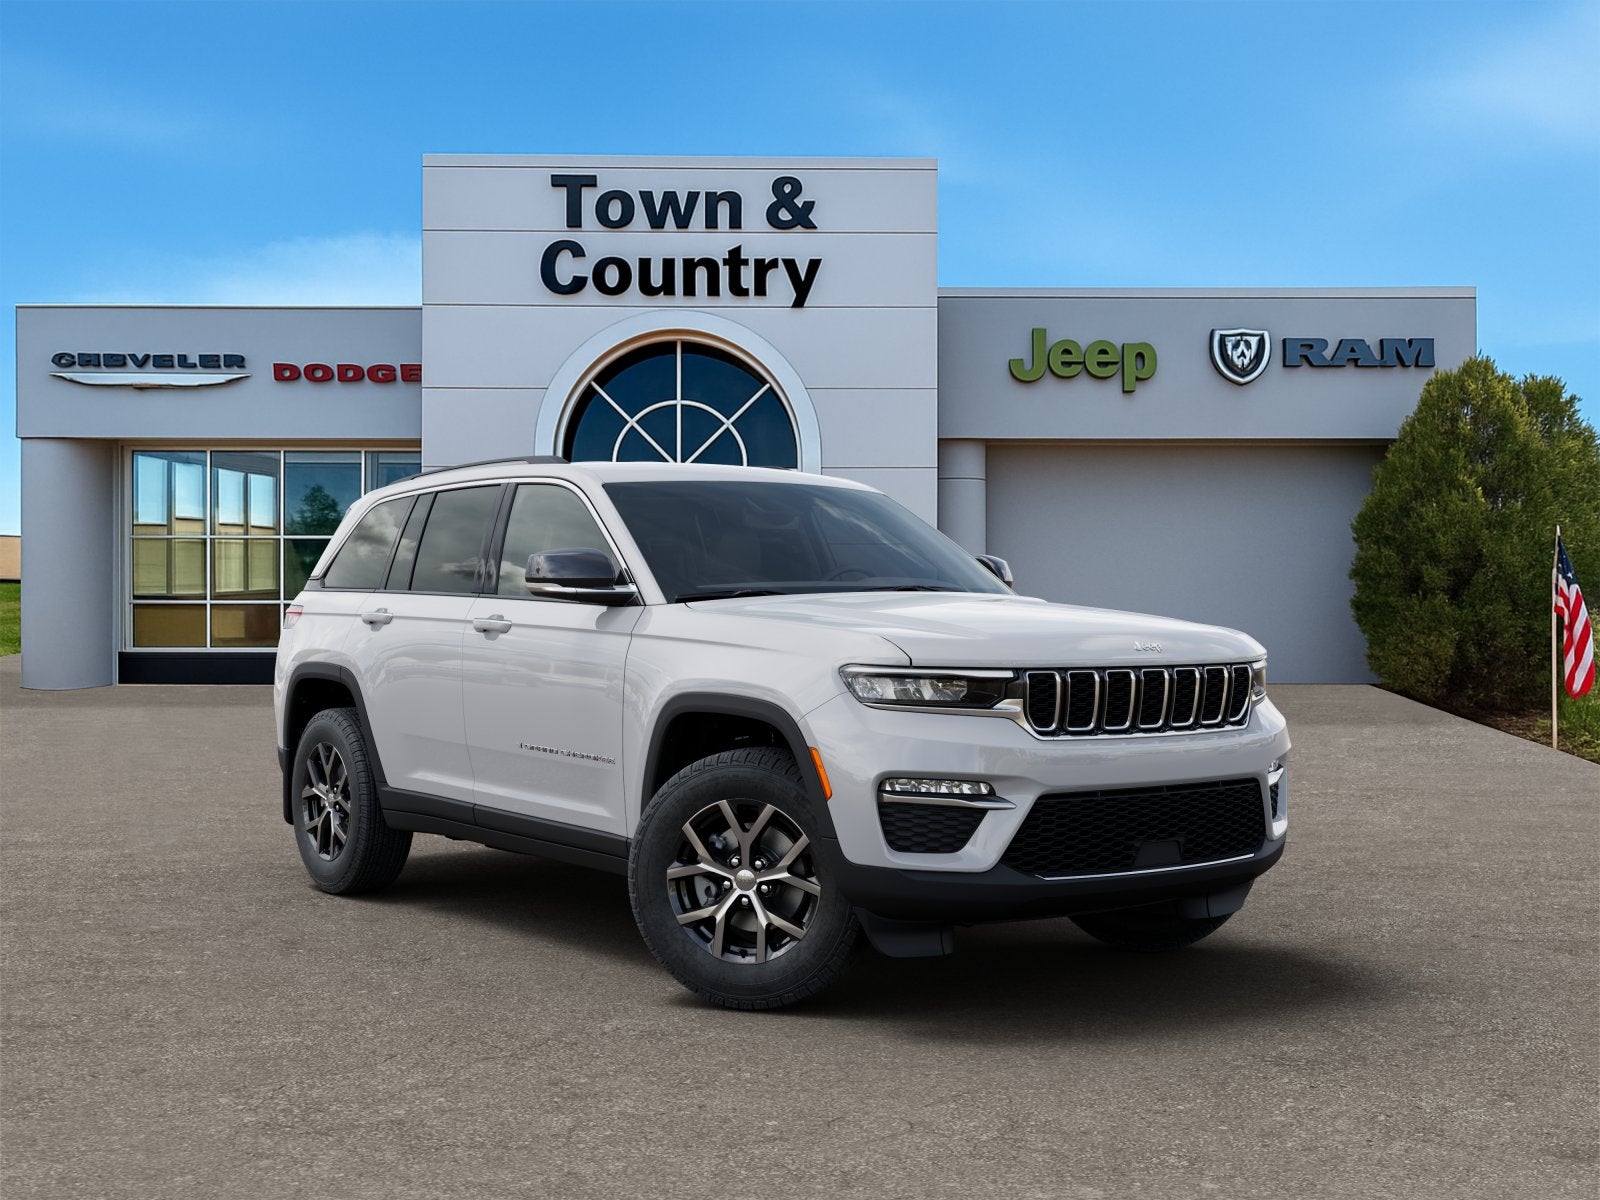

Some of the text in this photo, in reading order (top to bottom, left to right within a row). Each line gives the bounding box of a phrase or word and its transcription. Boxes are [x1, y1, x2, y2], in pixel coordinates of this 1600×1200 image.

[550, 174, 818, 230] Town &
[540, 239, 822, 308] Country
[273, 363, 422, 383] DODGE
[1009, 328, 1157, 392] Jeep
[1282, 337, 1435, 368] RAM
[1133, 640, 1161, 653] Jeep
